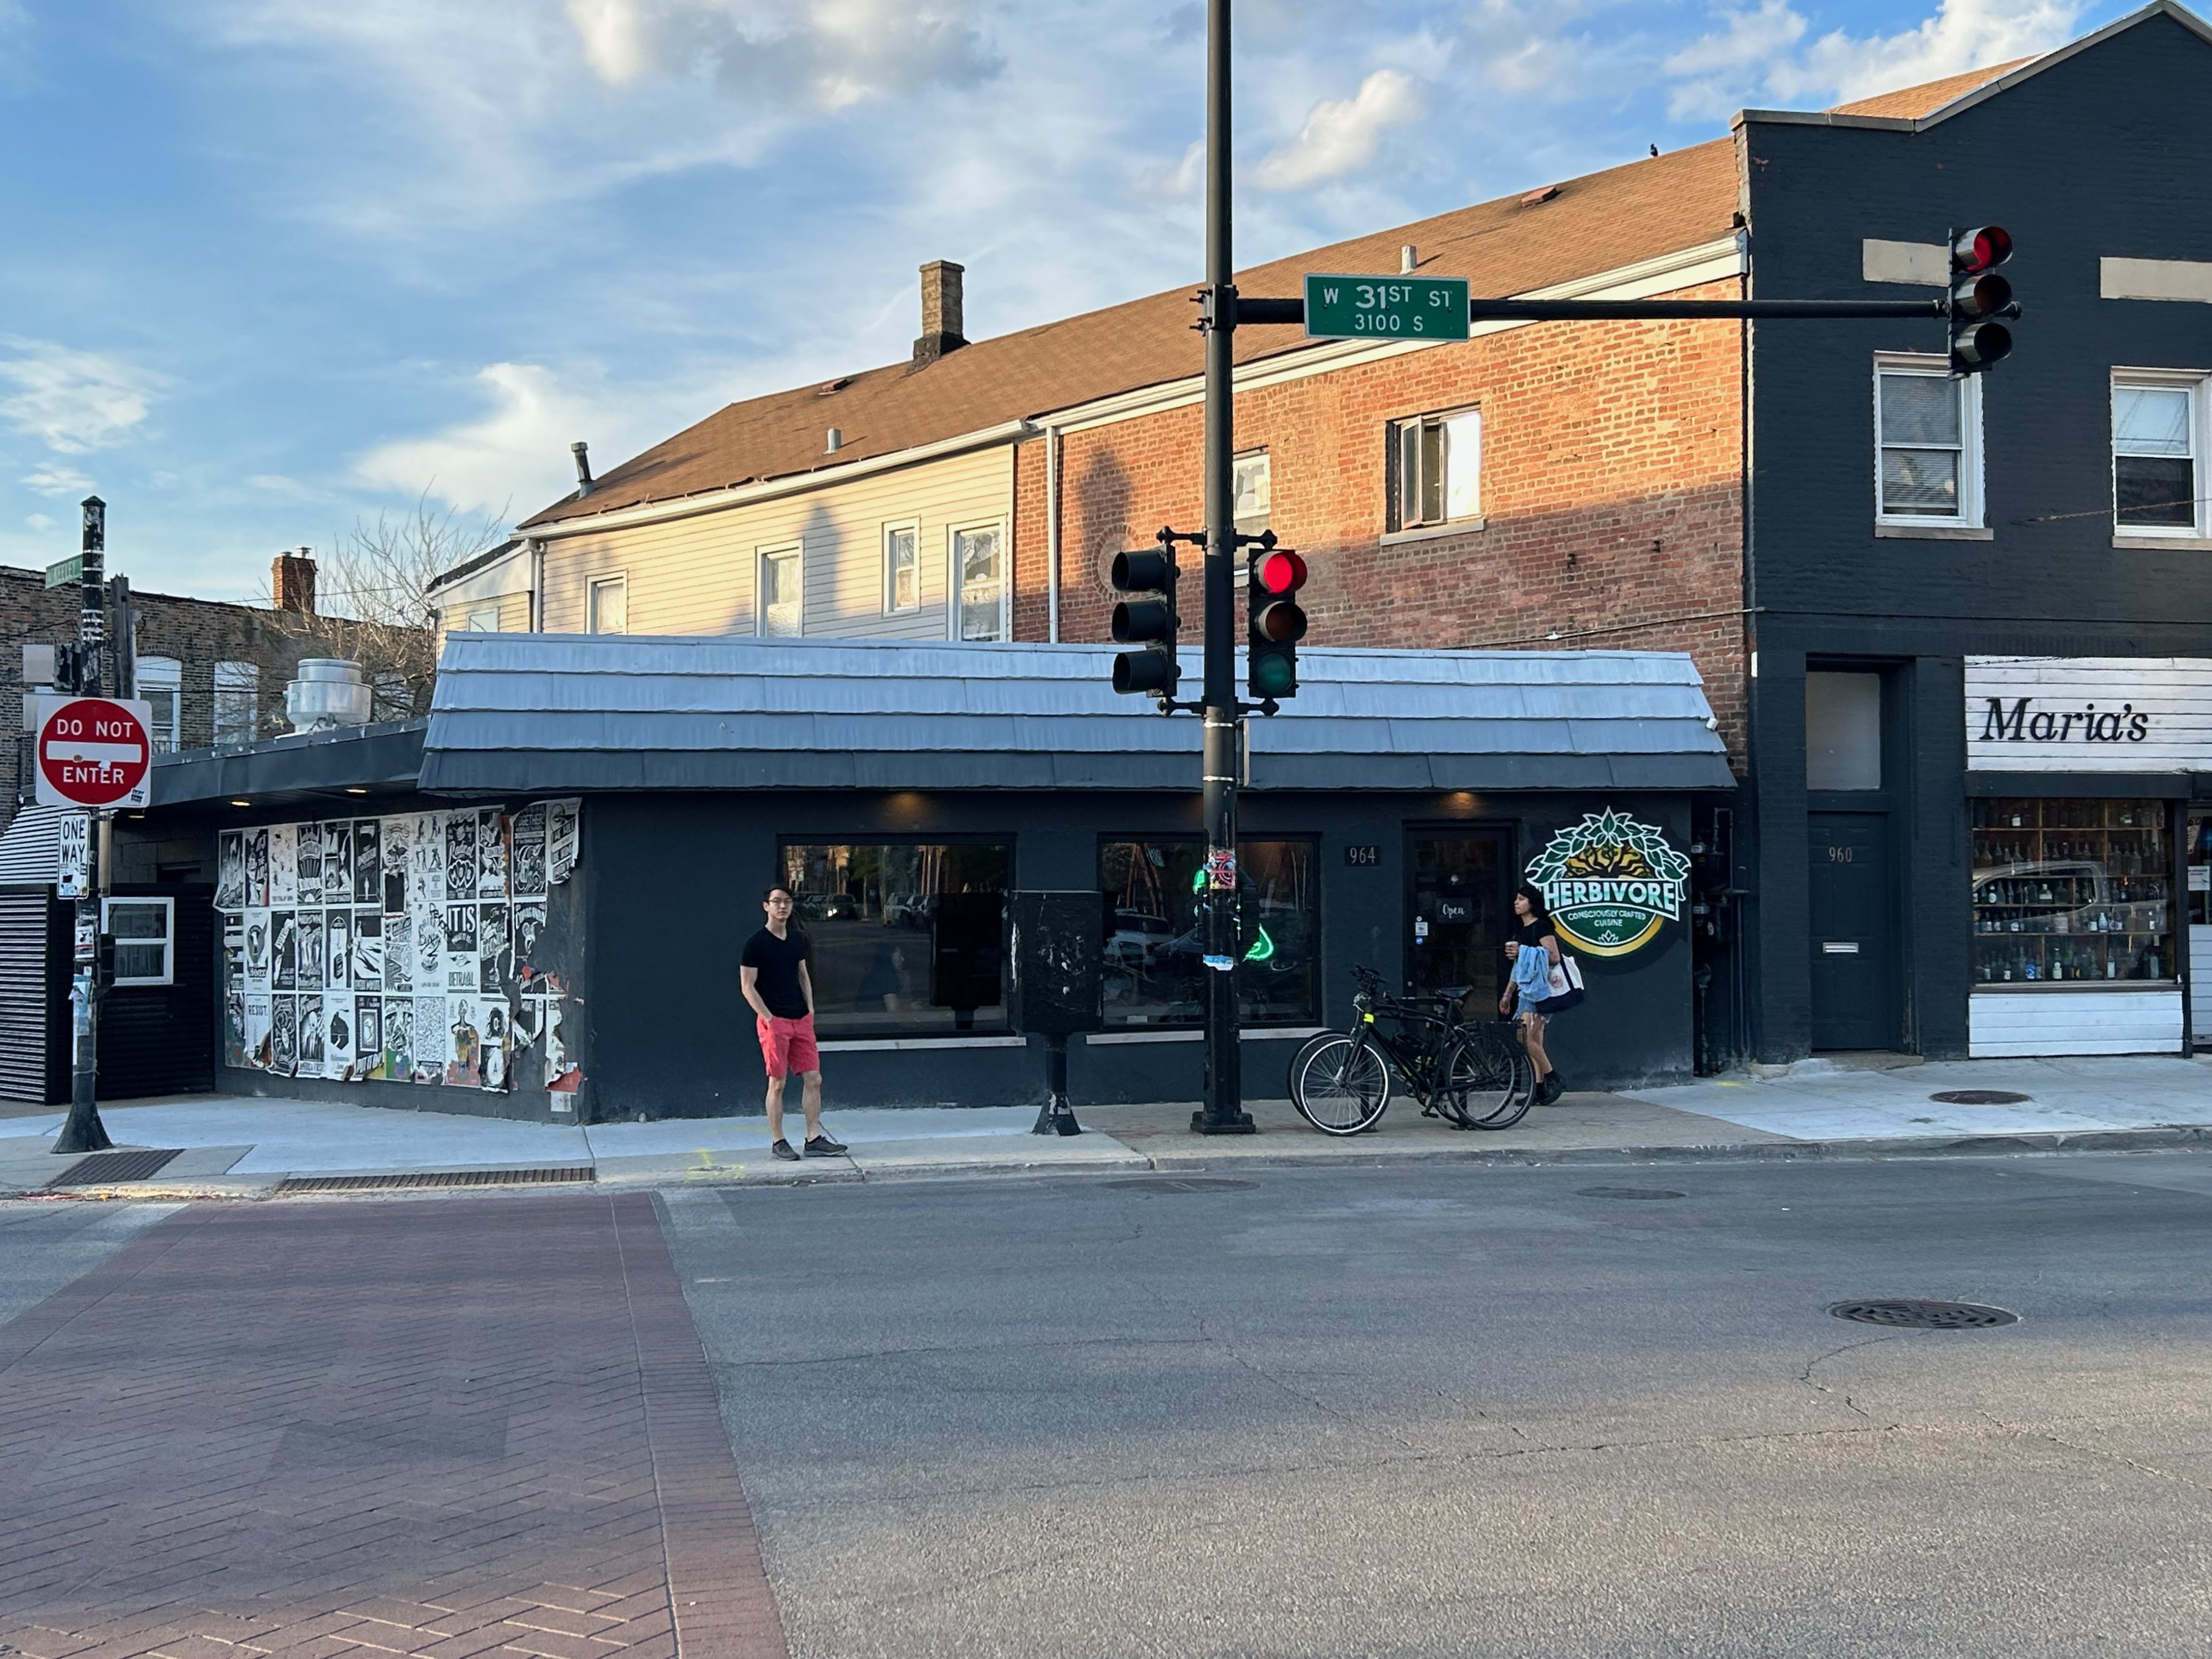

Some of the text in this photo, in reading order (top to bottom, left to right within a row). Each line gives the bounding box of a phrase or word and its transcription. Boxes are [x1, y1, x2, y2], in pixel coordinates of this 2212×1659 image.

[1323, 285, 1450, 309] W 31ST ST
[1355, 314, 1423, 332] 3100 S
[1979, 696, 2149, 742] Maria's
[57, 719, 134, 738] DO NOT
[63, 766, 124, 784] ENTER
[63, 819, 86, 840] ONE
[62, 843, 86, 863] WAY
[1350, 847, 1376, 863] 964
[1828, 846, 1853, 862] 960
[1543, 881, 1676, 911] HERBIVORE
[448, 906, 476, 933] IT IS
[1442, 903, 1465, 919] Open
[1567, 909, 1646, 921] CONSCIOUSLY CRAFTED
[1593, 918, 1623, 927] CUISINE
